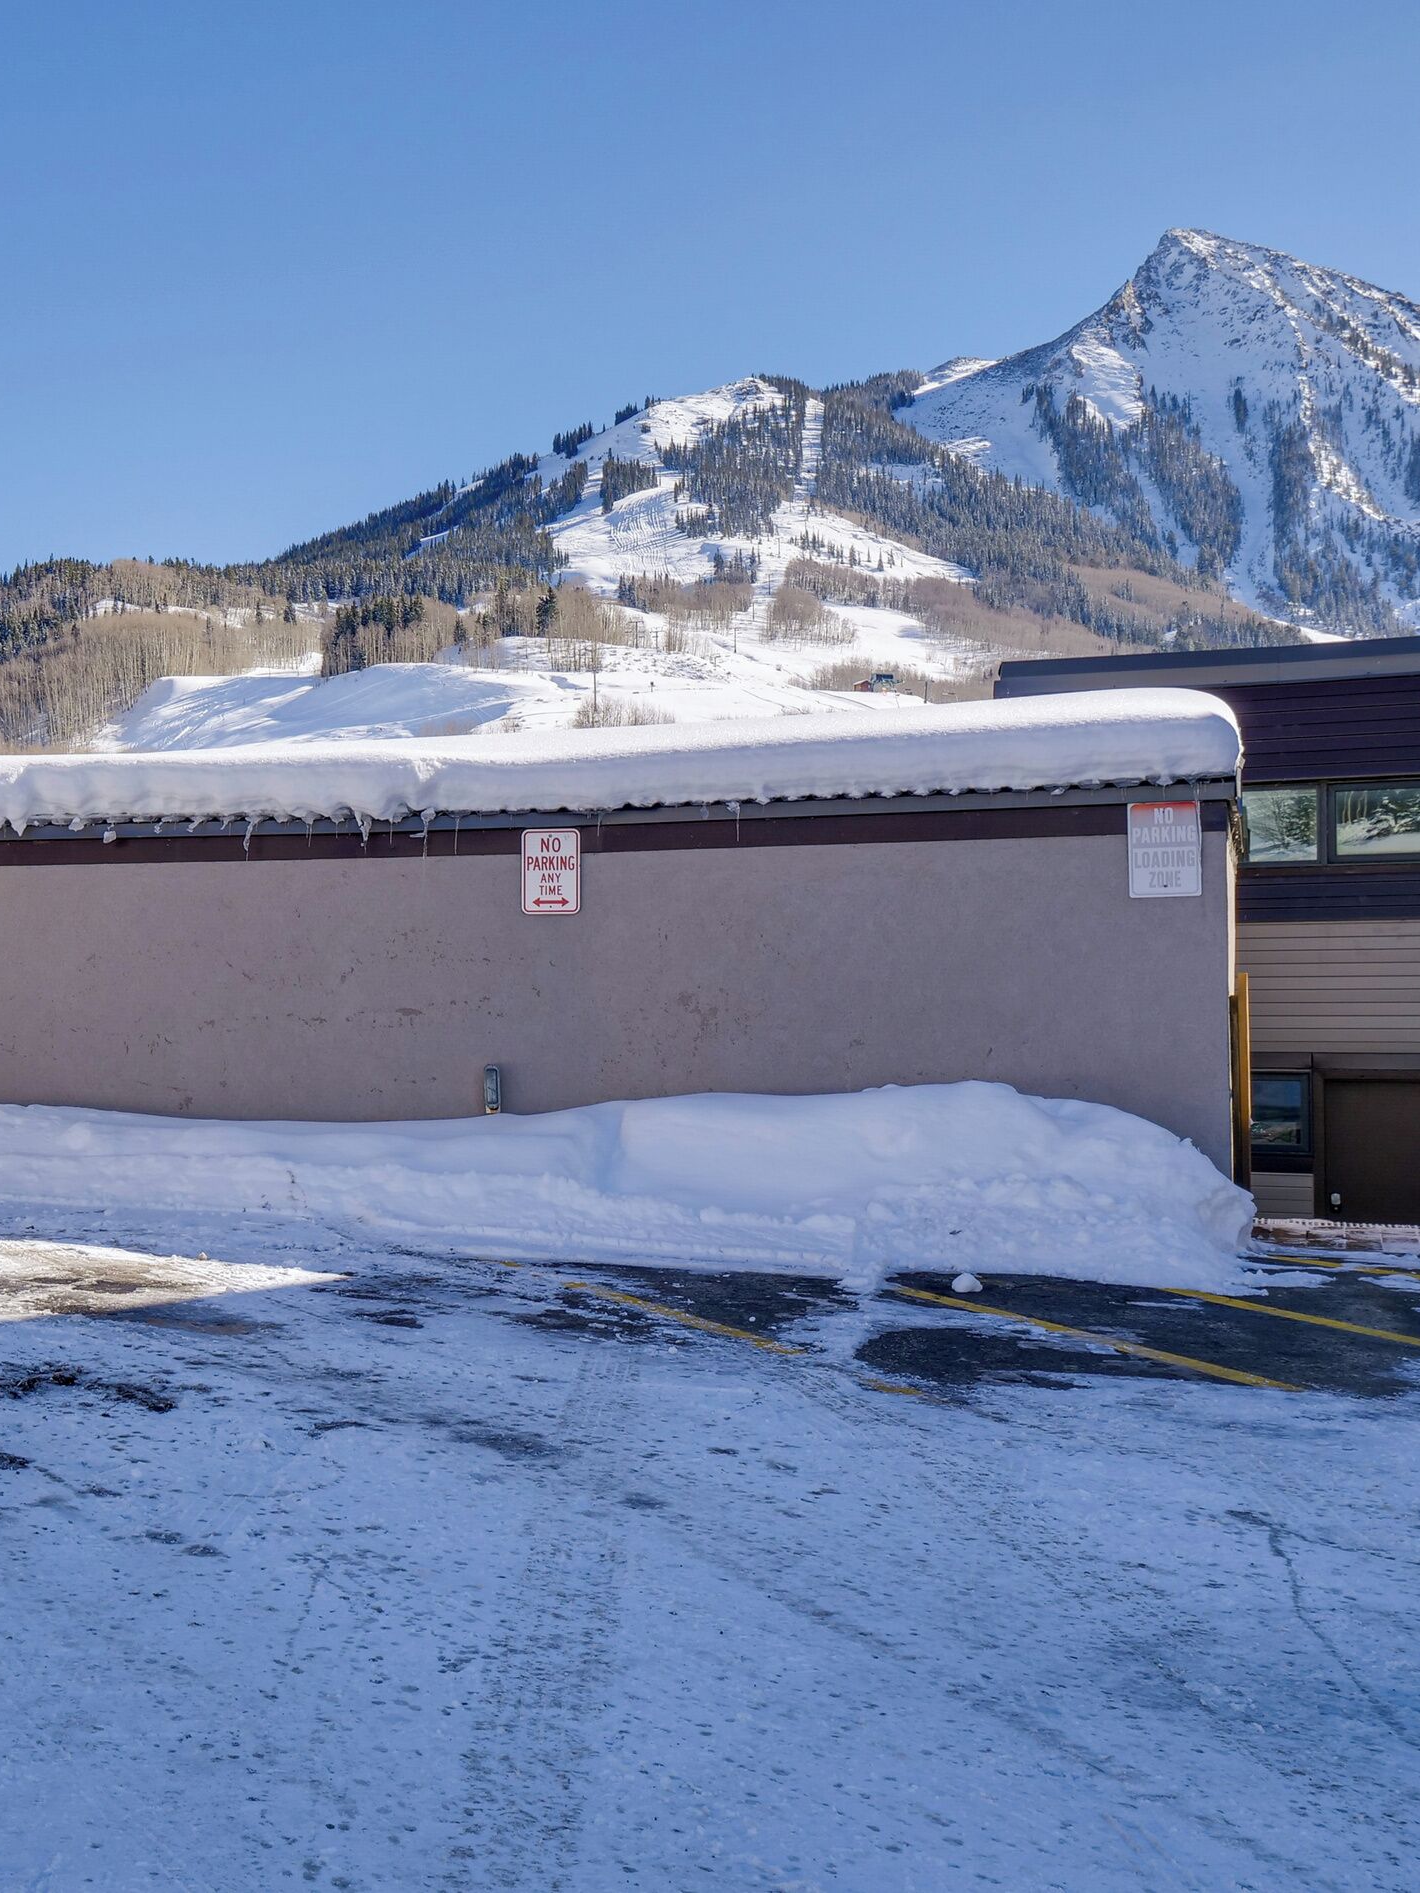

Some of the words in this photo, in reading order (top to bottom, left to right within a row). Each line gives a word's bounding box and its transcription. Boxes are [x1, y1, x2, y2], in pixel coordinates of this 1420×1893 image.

[1153, 807, 1173, 825] NO
[1132, 825, 1197, 844] PARKING
[540, 837, 561, 853] NO
[526, 855, 575, 871] PARKING
[1134, 849, 1196, 869] LOADING
[540, 873, 561, 884] ANY
[1149, 870, 1182, 889] ZONE
[539, 885, 563, 896] TIME
